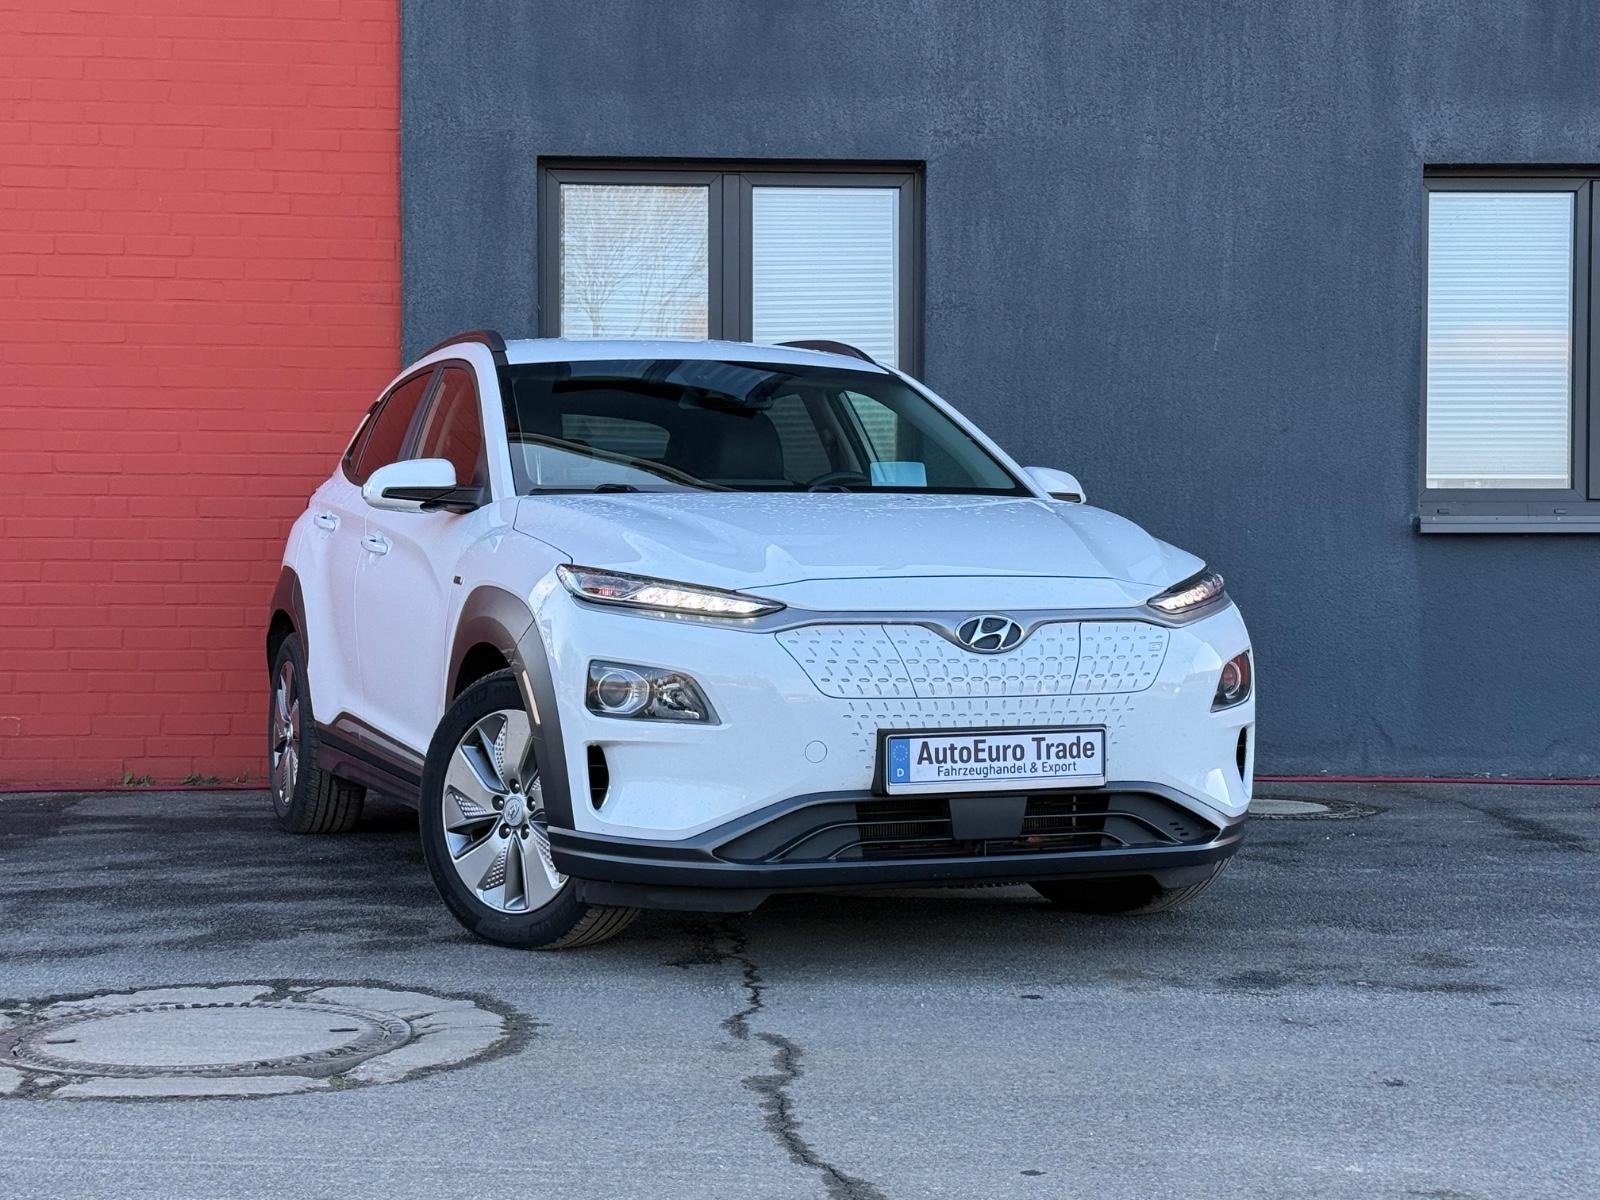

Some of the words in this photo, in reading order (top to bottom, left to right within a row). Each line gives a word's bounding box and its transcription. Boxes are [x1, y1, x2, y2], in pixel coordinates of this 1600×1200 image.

[916, 739, 1025, 765] AutoEuro
[1031, 735, 1095, 761] Trade
[896, 768, 905, 777] D
[937, 763, 1026, 779] Fahrzeughandel
[1030, 763, 1038, 774] &
[1041, 760, 1077, 775] Export
